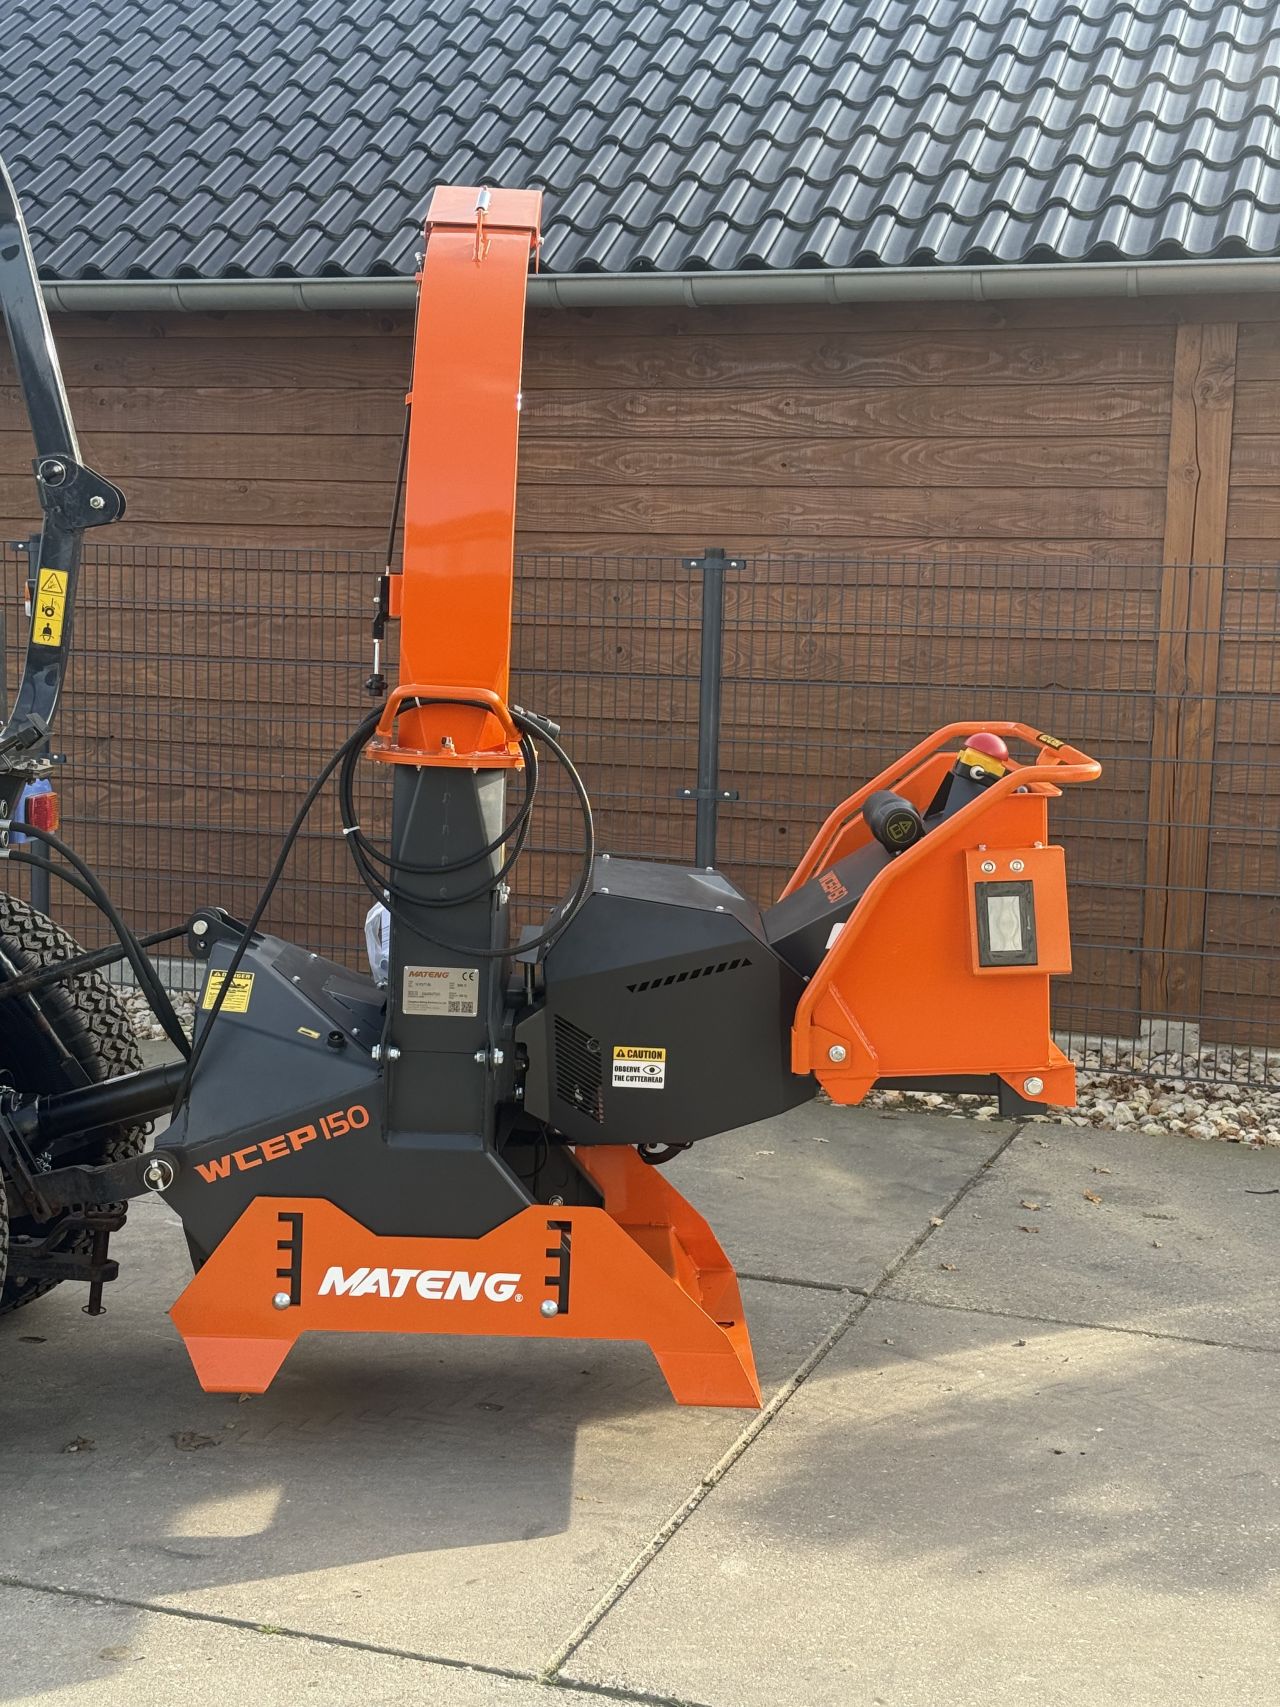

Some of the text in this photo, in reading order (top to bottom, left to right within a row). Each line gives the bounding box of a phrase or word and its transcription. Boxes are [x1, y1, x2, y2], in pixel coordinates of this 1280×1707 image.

[408, 971, 449, 979] MATENG
[627, 1049, 662, 1059] CAUTION
[614, 1065, 640, 1073] OBSERVE
[614, 1074, 625, 1082] THE
